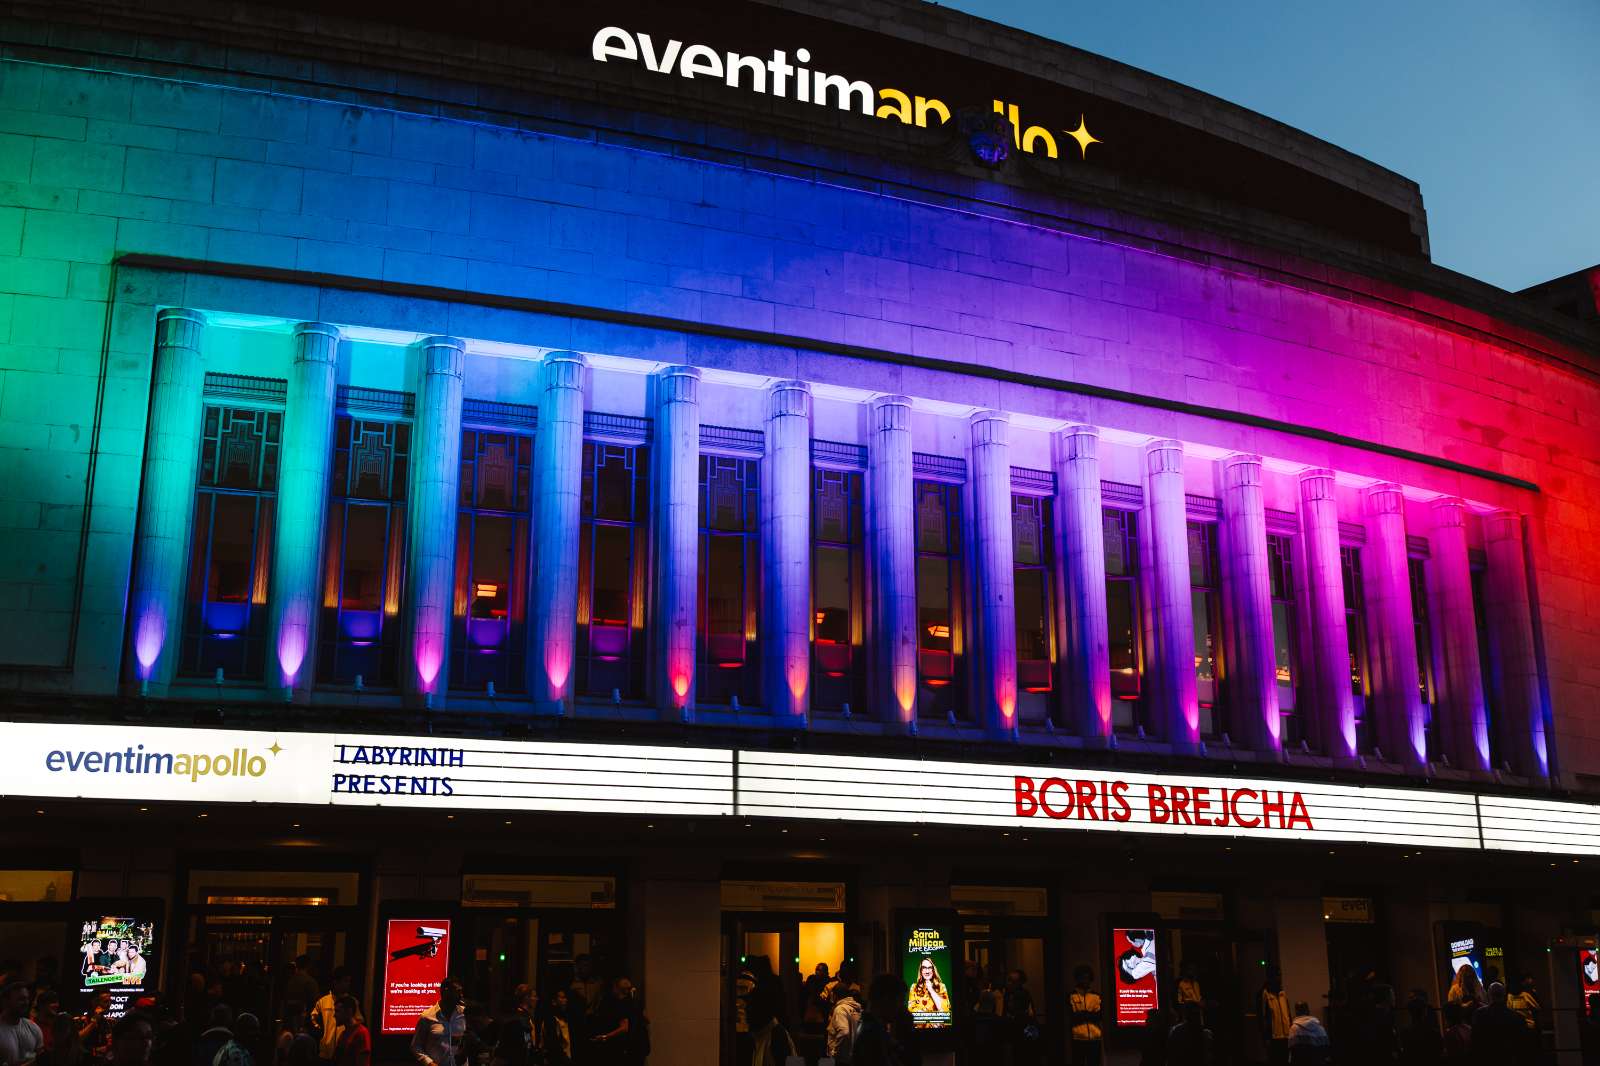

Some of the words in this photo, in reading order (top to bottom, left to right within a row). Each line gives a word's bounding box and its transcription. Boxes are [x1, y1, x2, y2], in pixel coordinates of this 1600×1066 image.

[45, 743, 268, 783] eventimapollo
[340, 744, 464, 768] LABYRINTH
[333, 773, 454, 797] PRESENTS
[1014, 775, 1132, 823] BORIS
[1147, 784, 1314, 831] BREJCHA
[909, 938, 945, 947] Millican
[913, 930, 940, 939] Sarah
